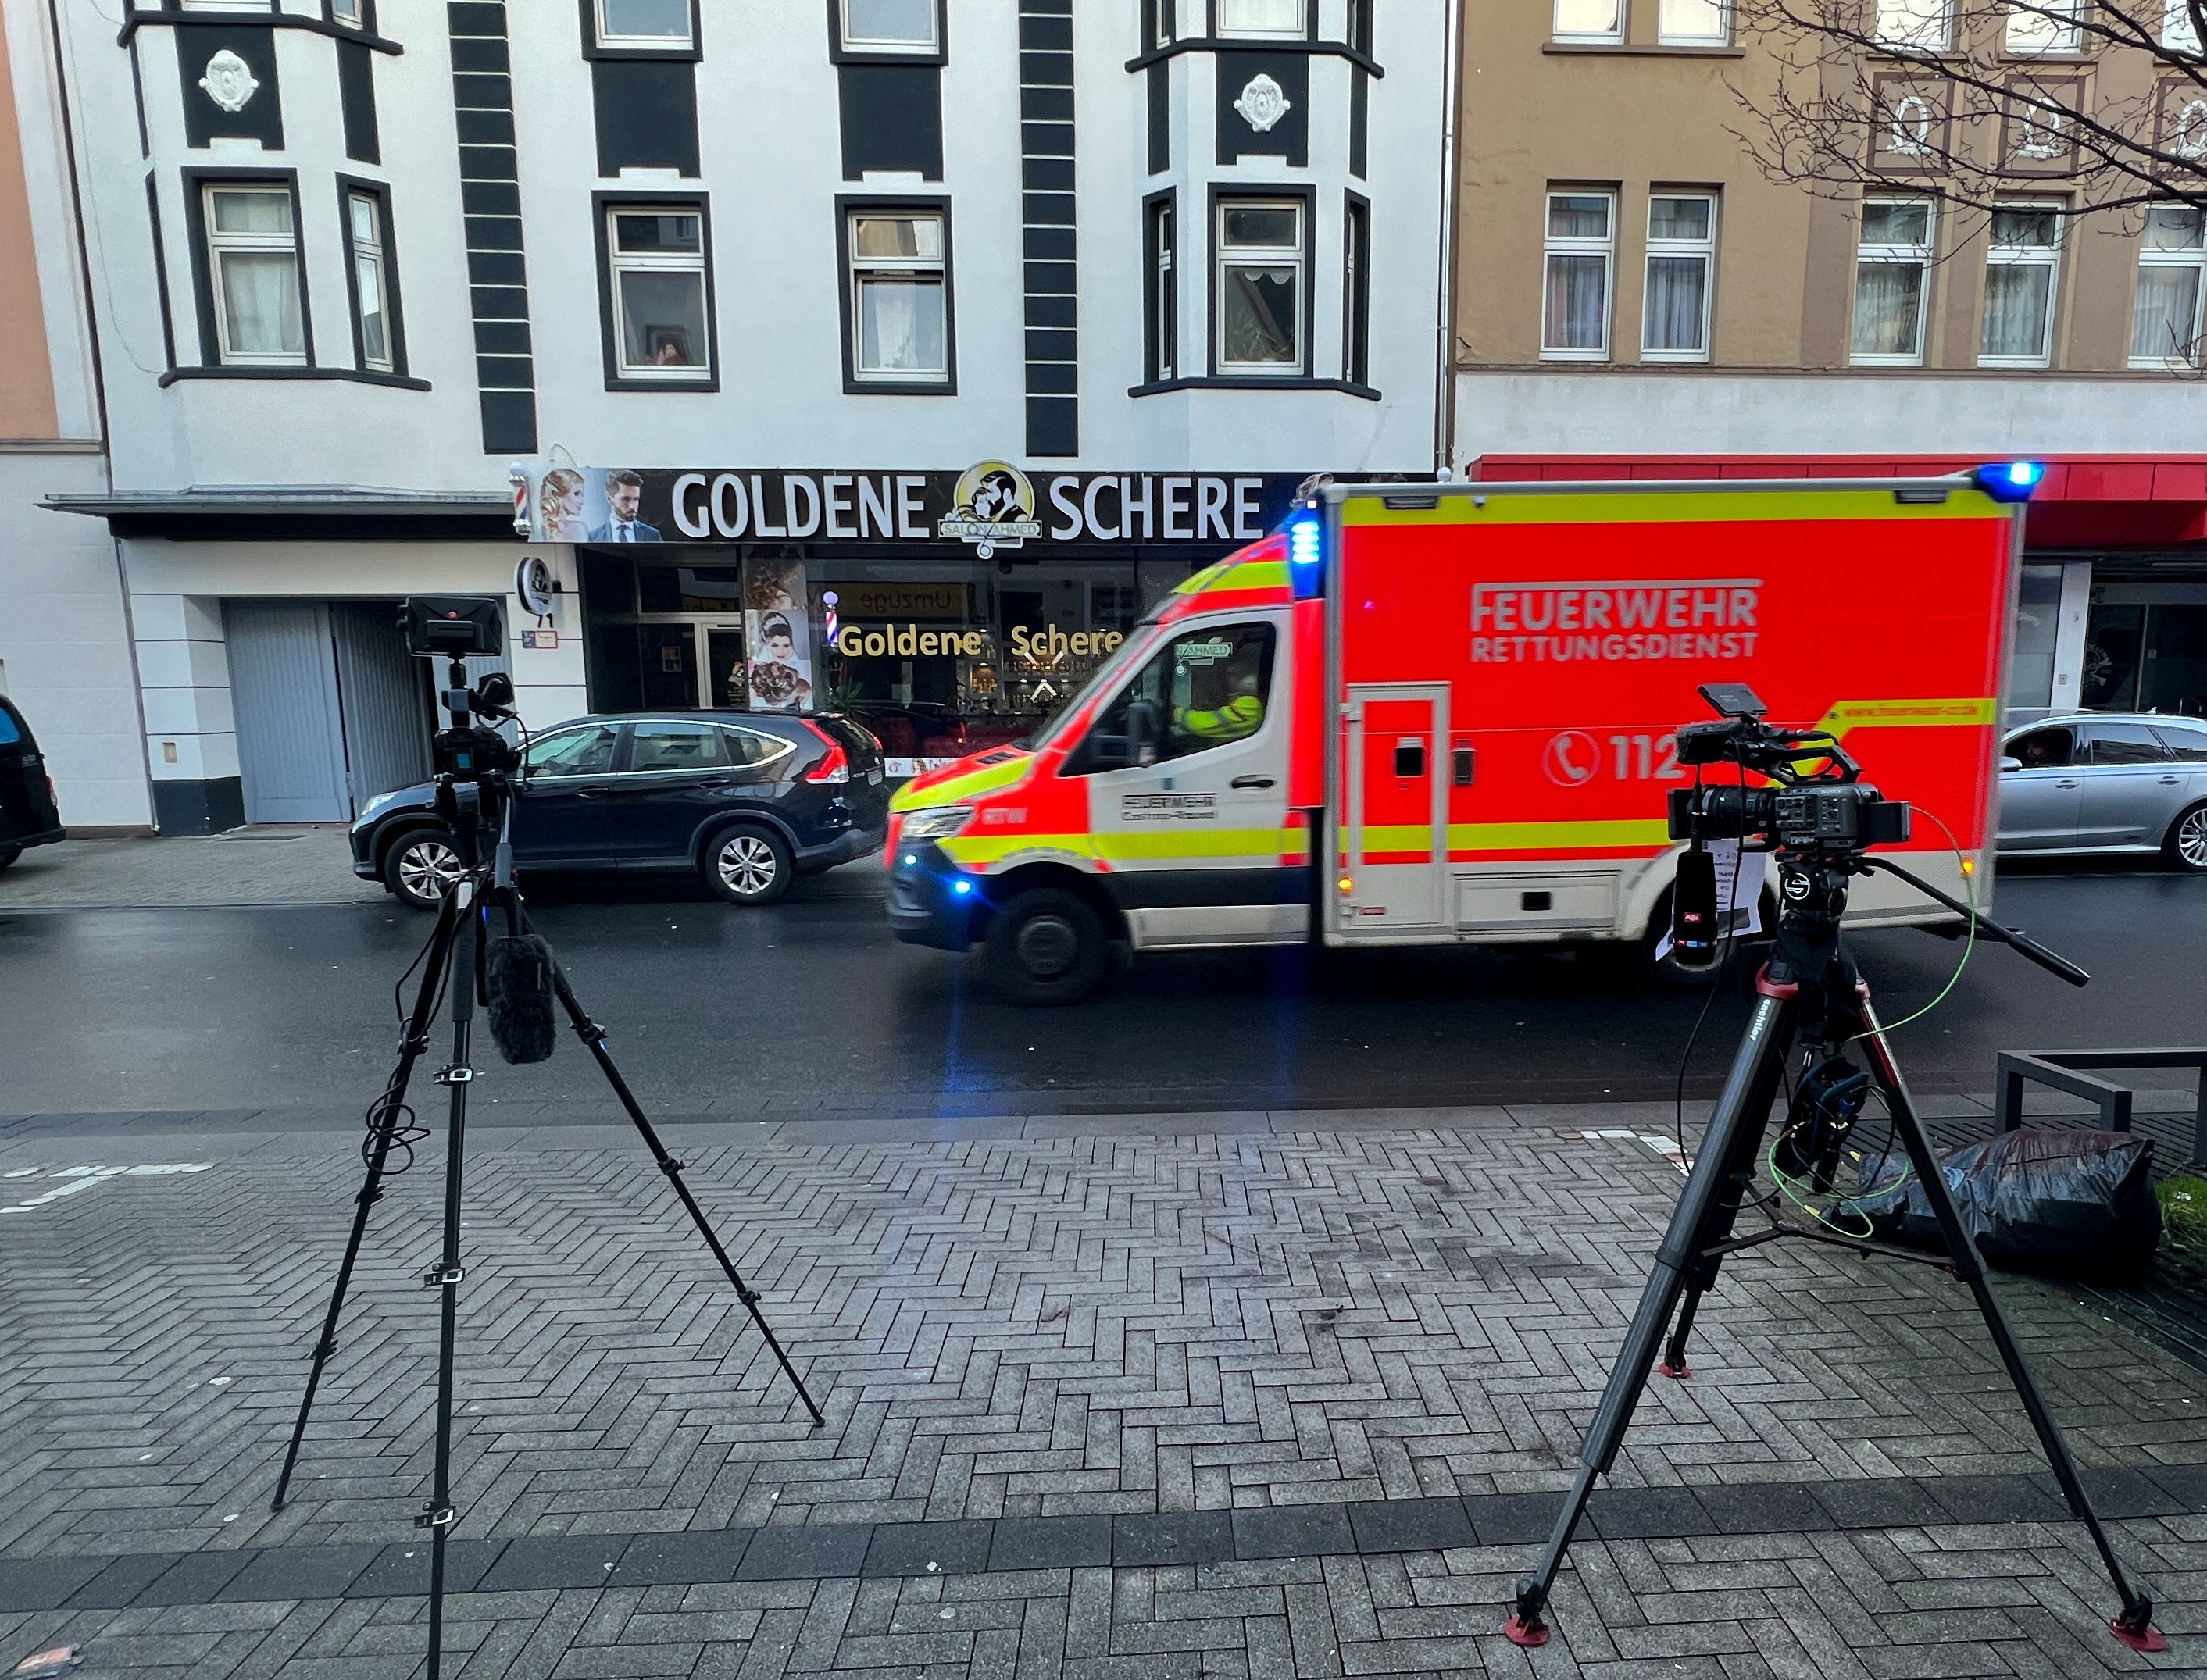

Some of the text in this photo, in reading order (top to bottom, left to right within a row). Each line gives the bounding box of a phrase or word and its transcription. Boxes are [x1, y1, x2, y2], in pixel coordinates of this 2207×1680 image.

[672, 473, 1265, 540] GOLDENE SCHERE
[943, 523, 1037, 535] SALON AHMED
[1470, 579, 1763, 632] FEUERWEHR
[838, 623, 1123, 657] Goldene Schere
[1470, 631, 1759, 662] RETTUNGSDIENST
[1609, 734, 1687, 781] 112
